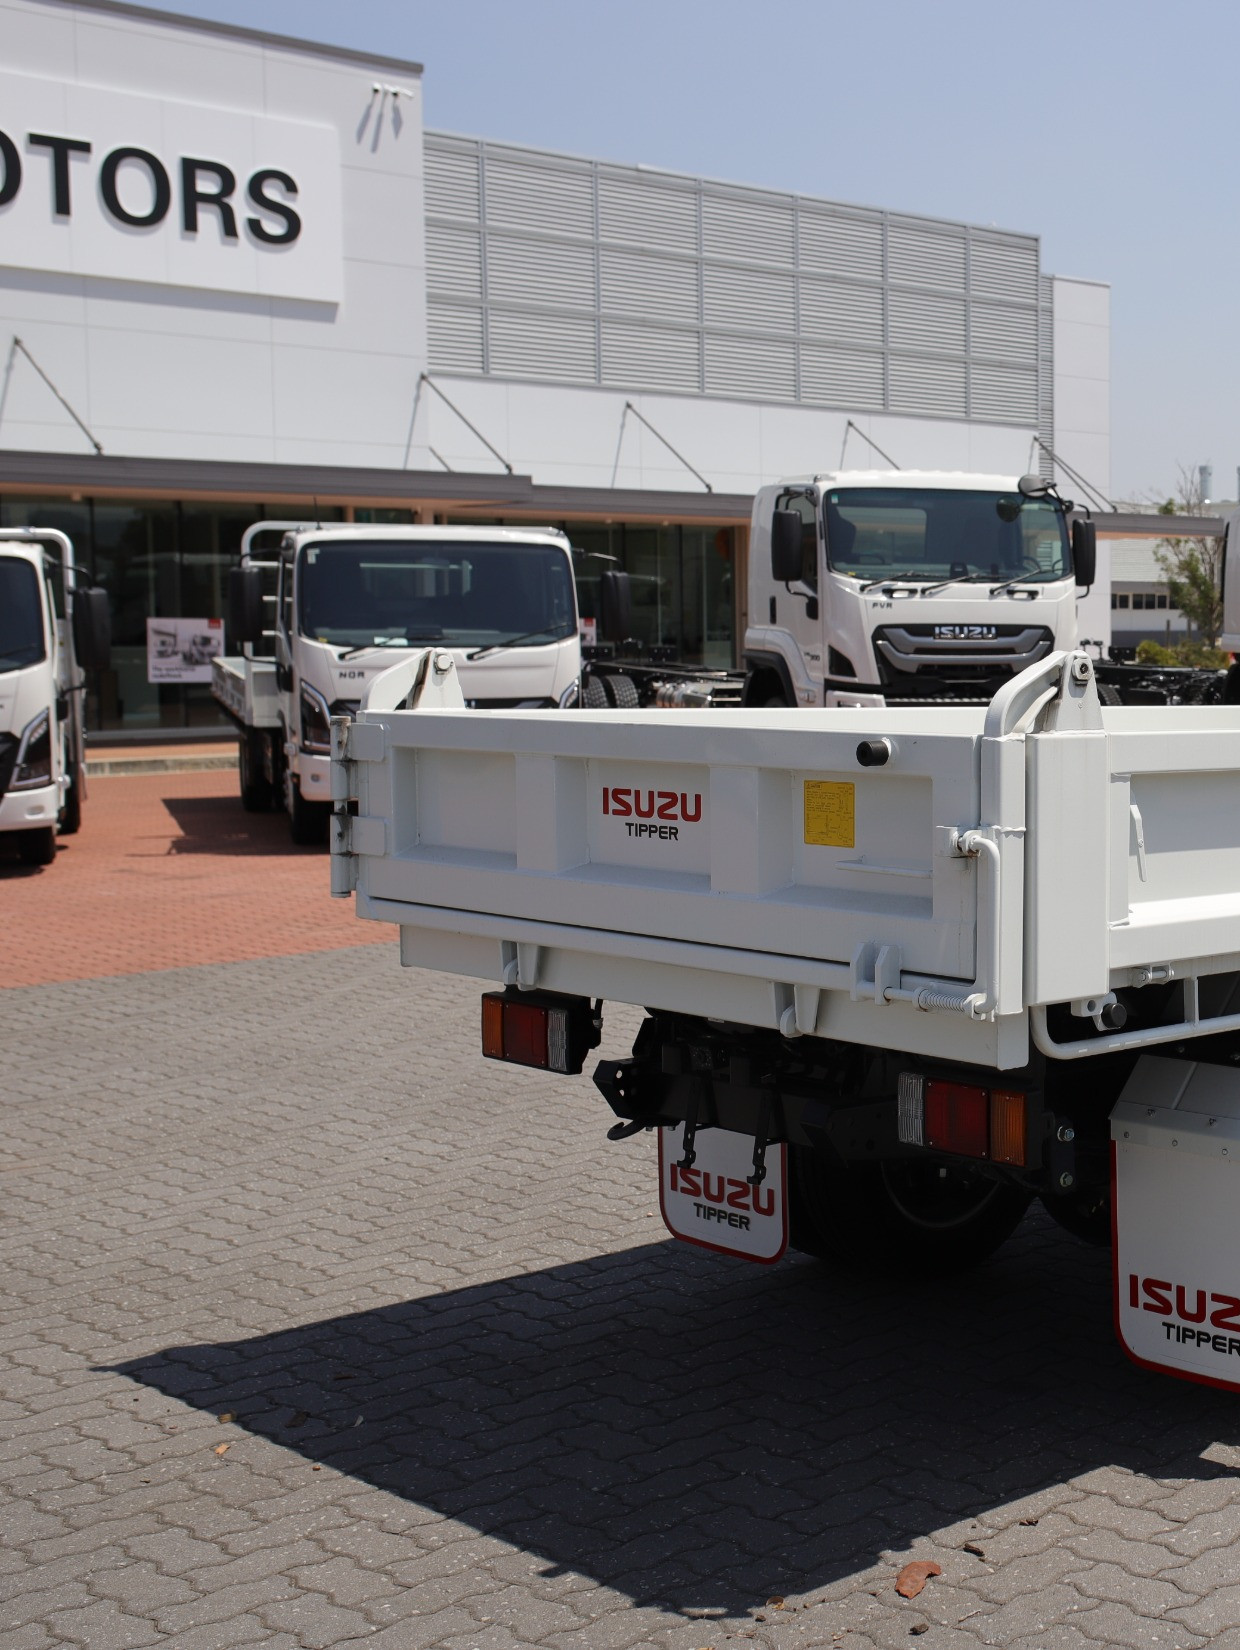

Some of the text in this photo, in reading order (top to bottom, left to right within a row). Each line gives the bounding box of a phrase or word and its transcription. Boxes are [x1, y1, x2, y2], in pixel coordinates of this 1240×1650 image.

[934, 626, 997, 639] ISUZU
[602, 786, 702, 823] ISUZU
[624, 821, 679, 842] TIPPER
[669, 1163, 775, 1217] ISUZU
[693, 1201, 751, 1232] TIPPER
